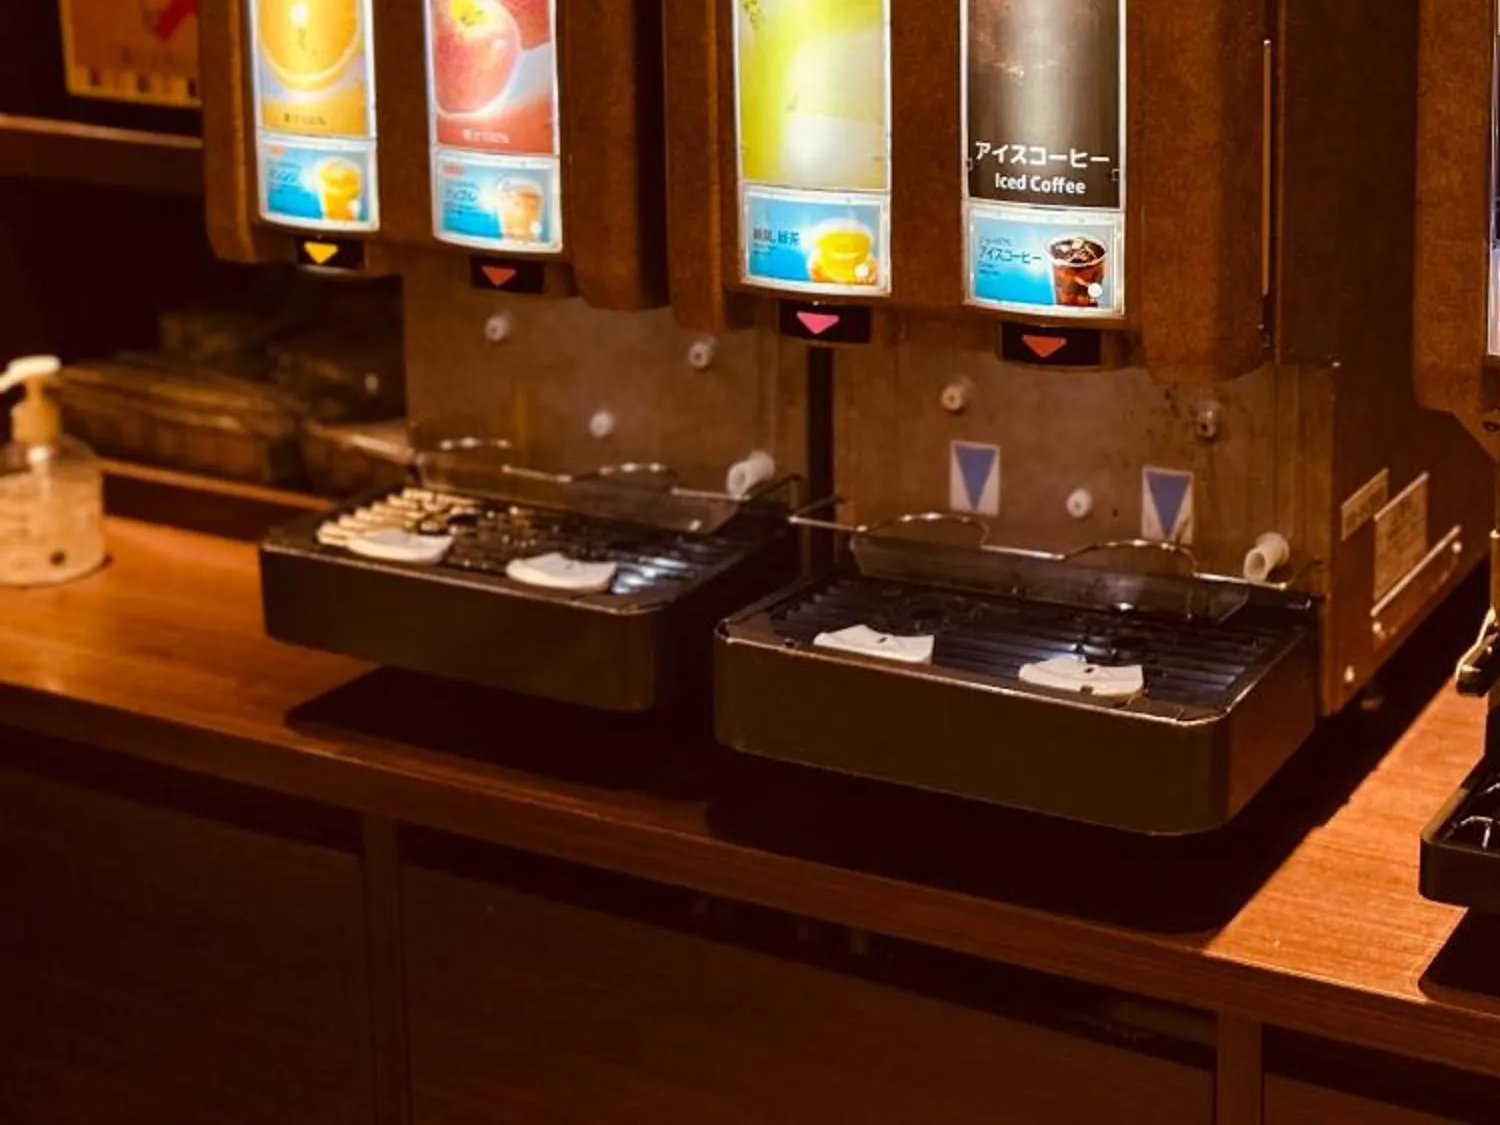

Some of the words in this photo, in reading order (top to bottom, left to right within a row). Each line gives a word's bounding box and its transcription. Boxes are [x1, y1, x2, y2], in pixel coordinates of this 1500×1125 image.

[975, 140, 1111, 168] アイスコーヒー
[995, 172, 1027, 190] Iced
[1030, 176, 1087, 194] Coffee
[979, 245, 1042, 265] アイスコーヒー
